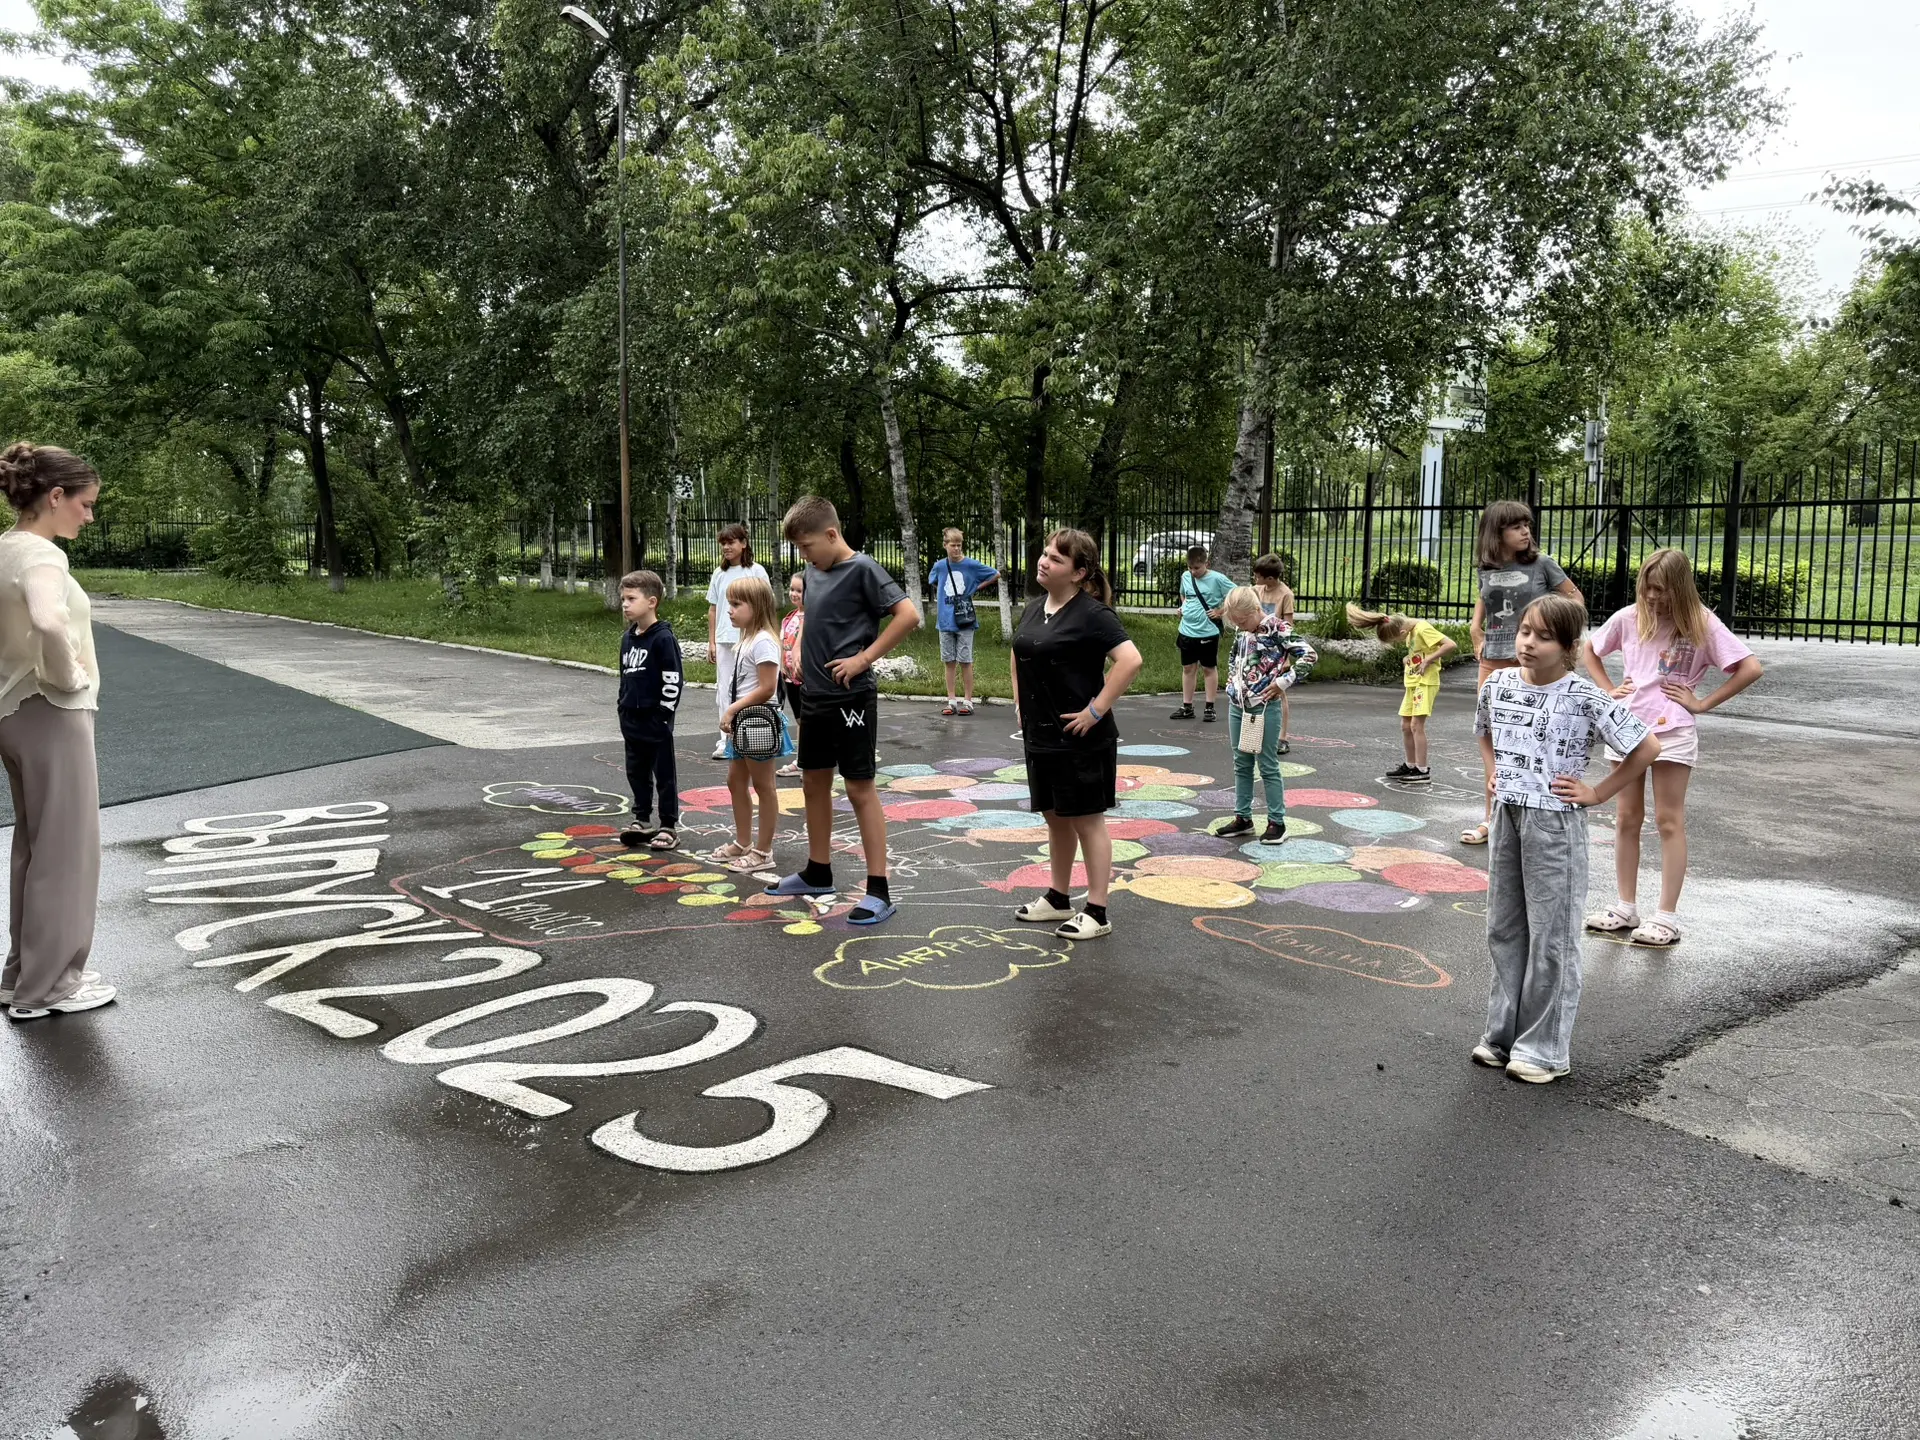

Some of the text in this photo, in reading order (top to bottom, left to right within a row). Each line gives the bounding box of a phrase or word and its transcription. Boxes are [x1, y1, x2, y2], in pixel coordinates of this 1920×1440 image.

[660, 670, 680, 712] BOY
[145, 801, 993, 1174] ВЫПУСК 2025
